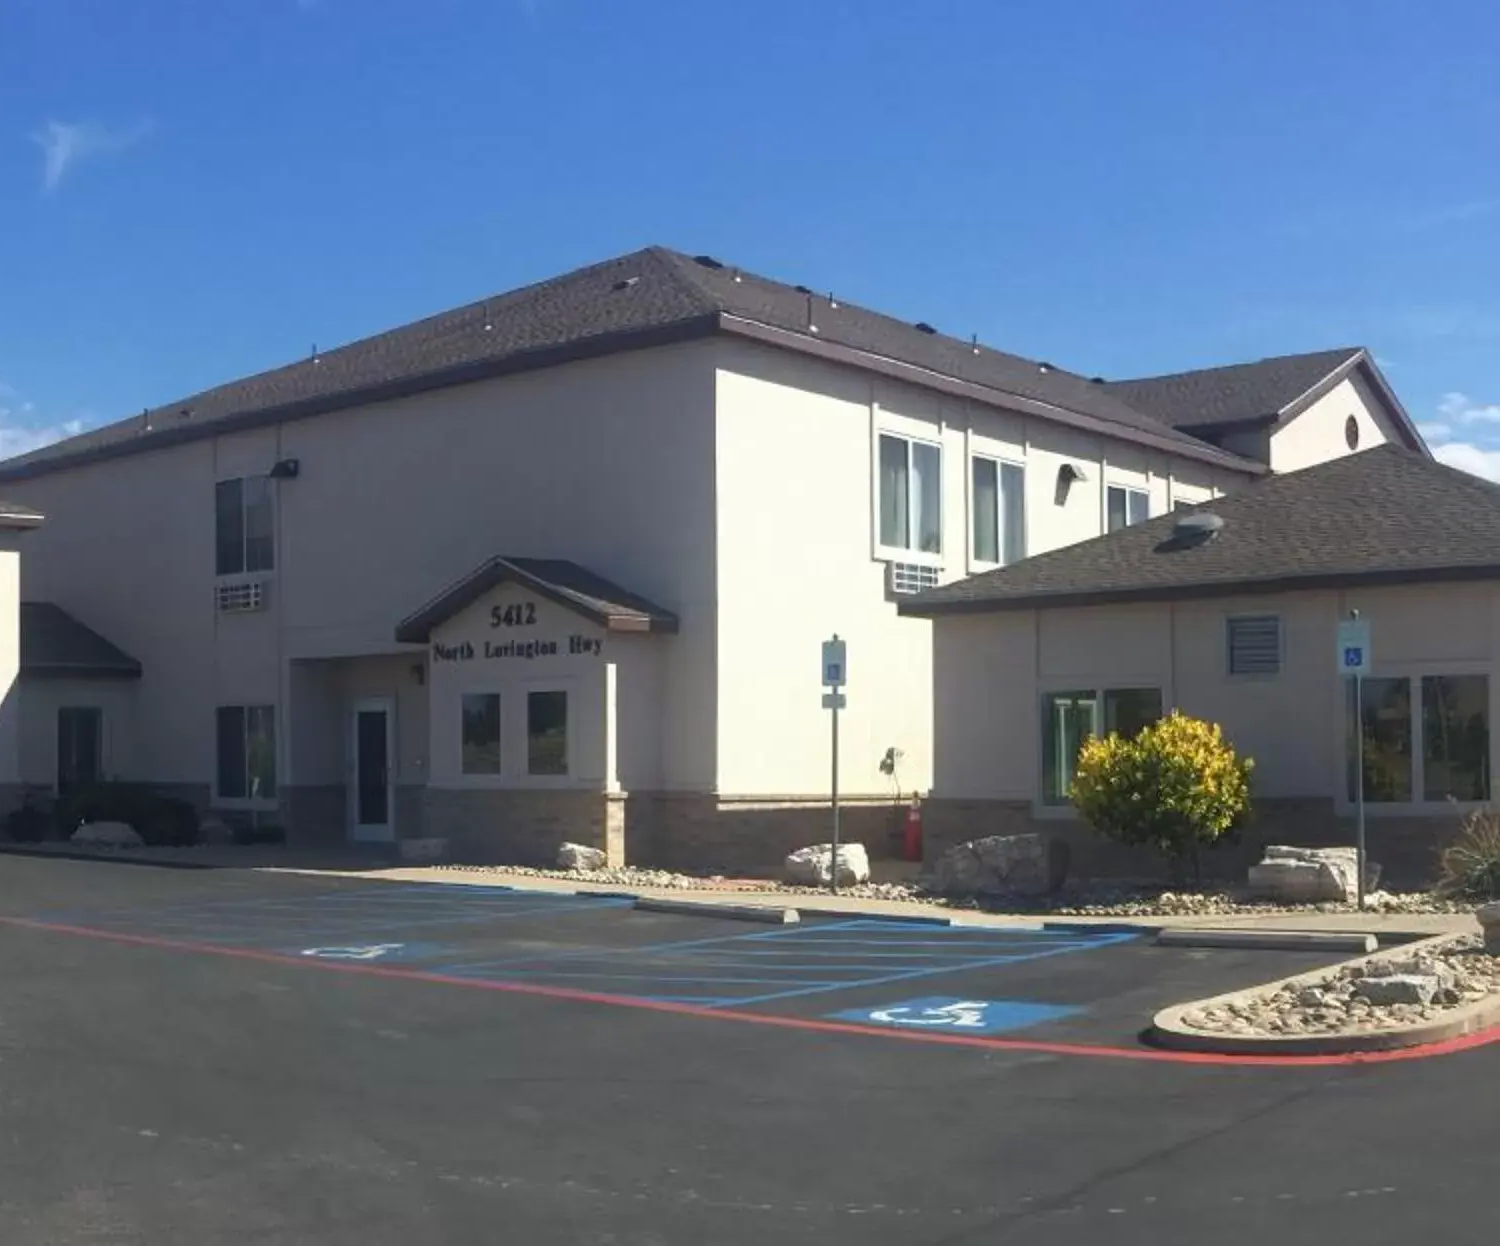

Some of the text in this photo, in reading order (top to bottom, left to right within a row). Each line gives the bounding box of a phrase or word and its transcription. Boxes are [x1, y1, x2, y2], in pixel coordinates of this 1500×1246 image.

[490, 602, 537, 628] 5412
[433, 641, 474, 661] North
[569, 634, 603, 656] Hwy
